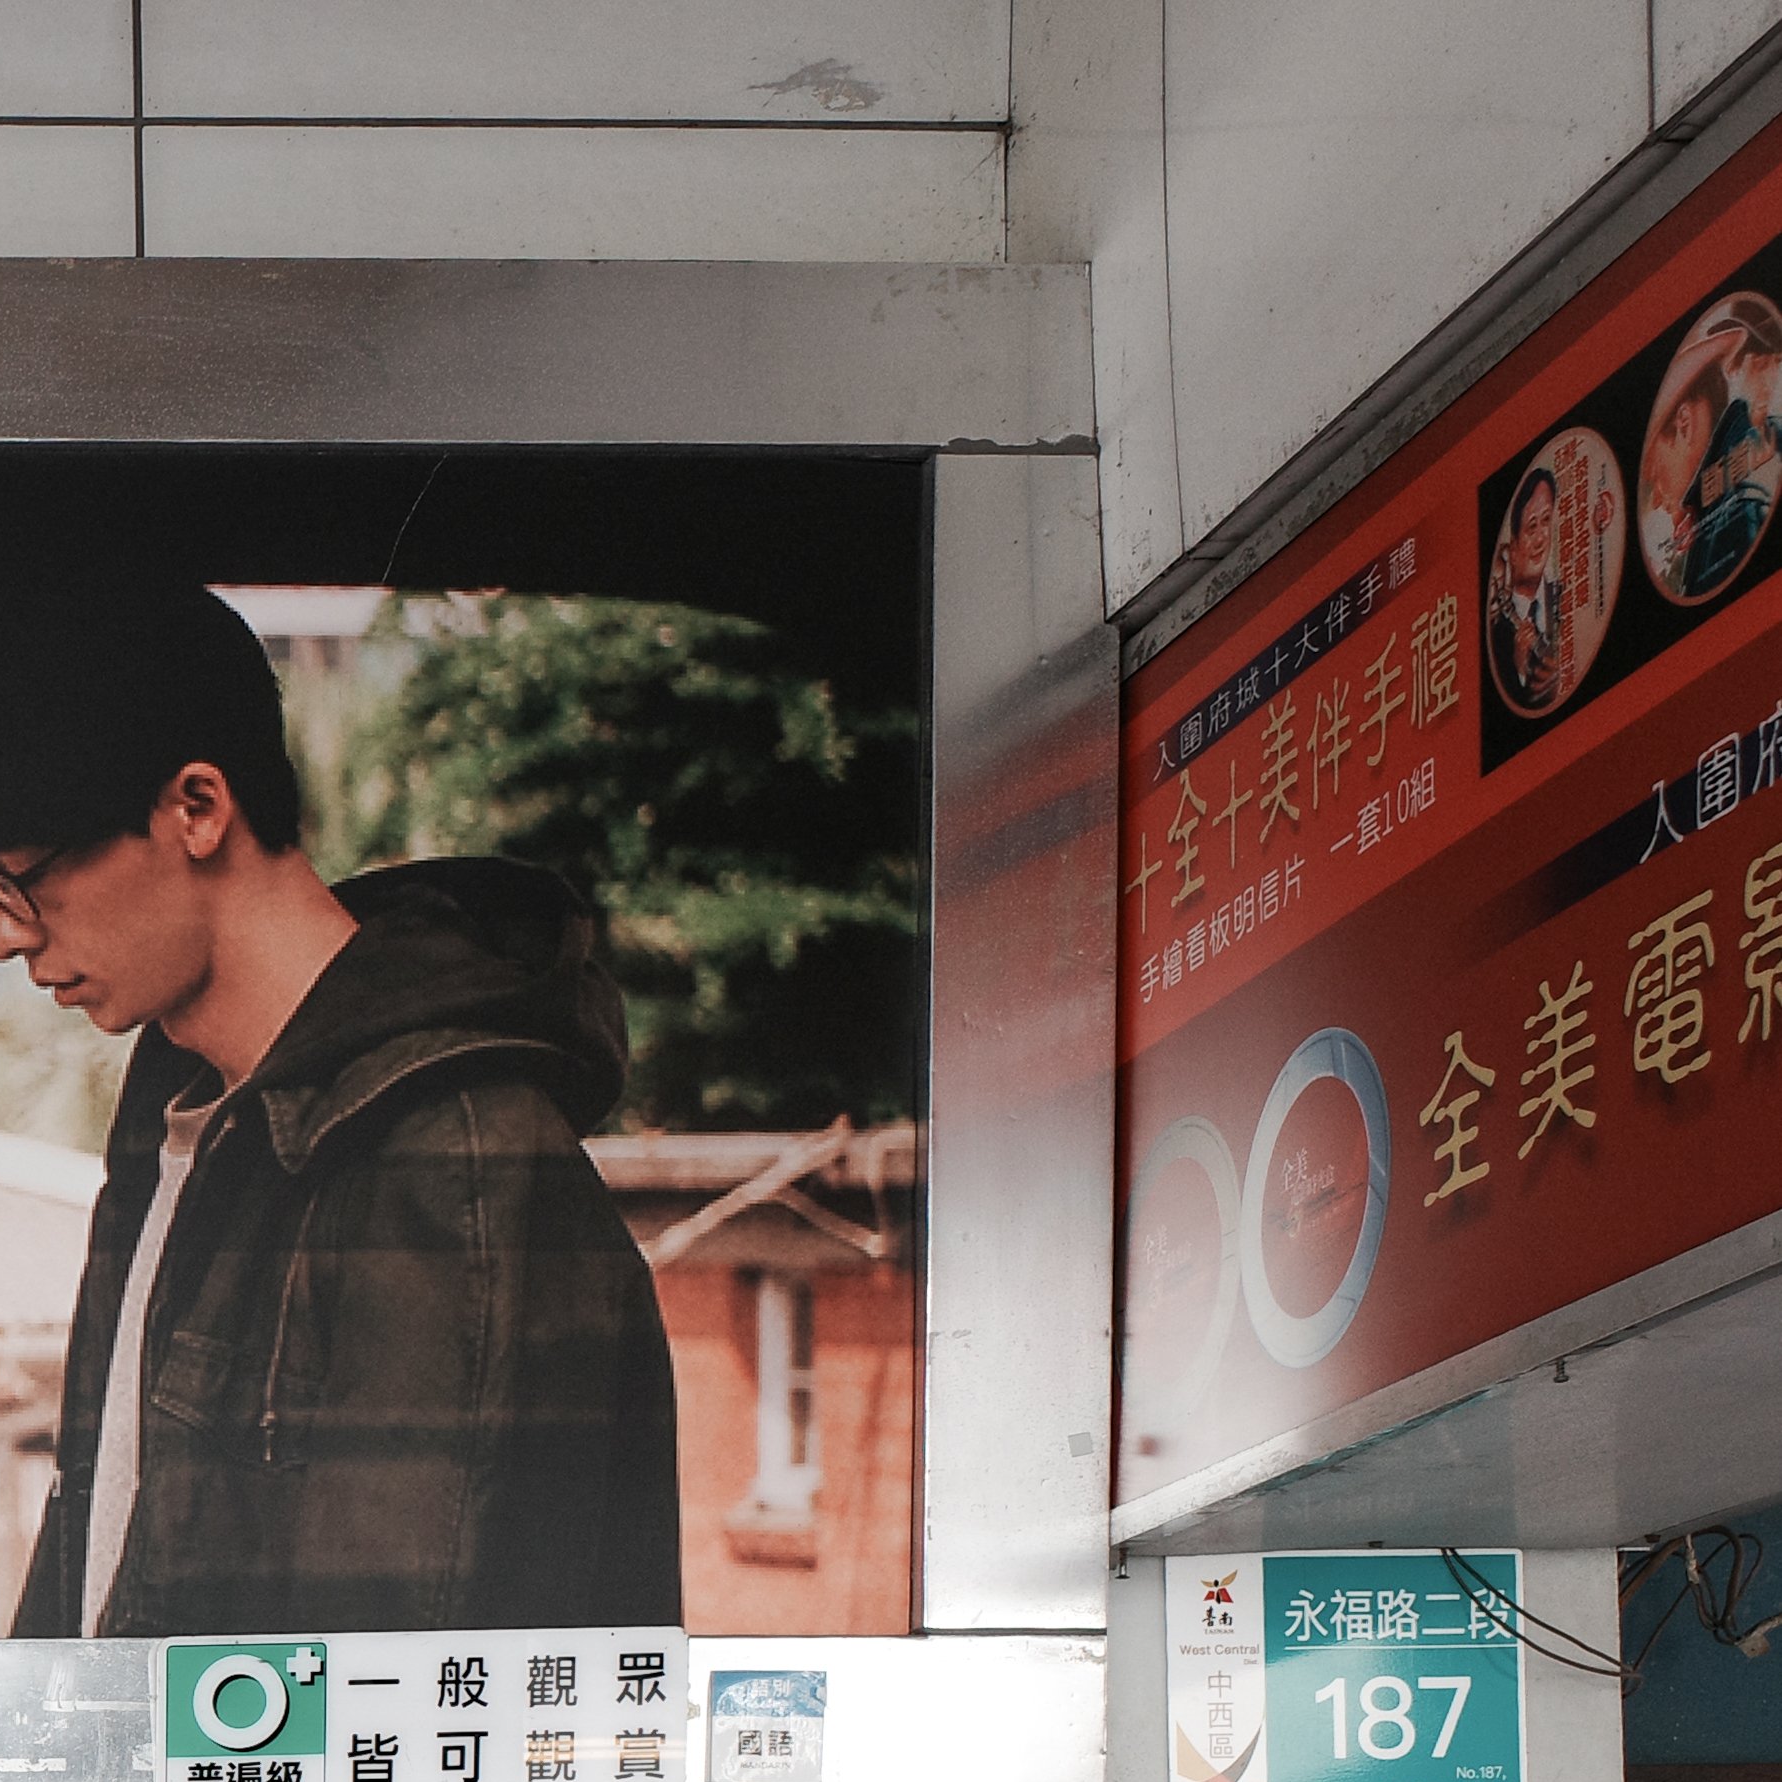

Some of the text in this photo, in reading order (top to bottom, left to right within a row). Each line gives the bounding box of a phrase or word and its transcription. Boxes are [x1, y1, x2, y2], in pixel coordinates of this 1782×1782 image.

[1150, 536, 1420, 783] 入圍府城十大伴手禮
[1124, 592, 1461, 933] 十全十美伴手禮
[1139, 758, 1437, 1004] 手繪看板明信片 一套10組
[1180, 1644, 1260, 1655] West Central
[1284, 1589, 1515, 1643] 永福路二段
[347, 1651, 667, 1708] 一般觀眾
[1208, 1670, 1234, 1758] 中西區
[1314, 1676, 1472, 1761] 187
[1456, 1765, 1507, 1781] No.187,
